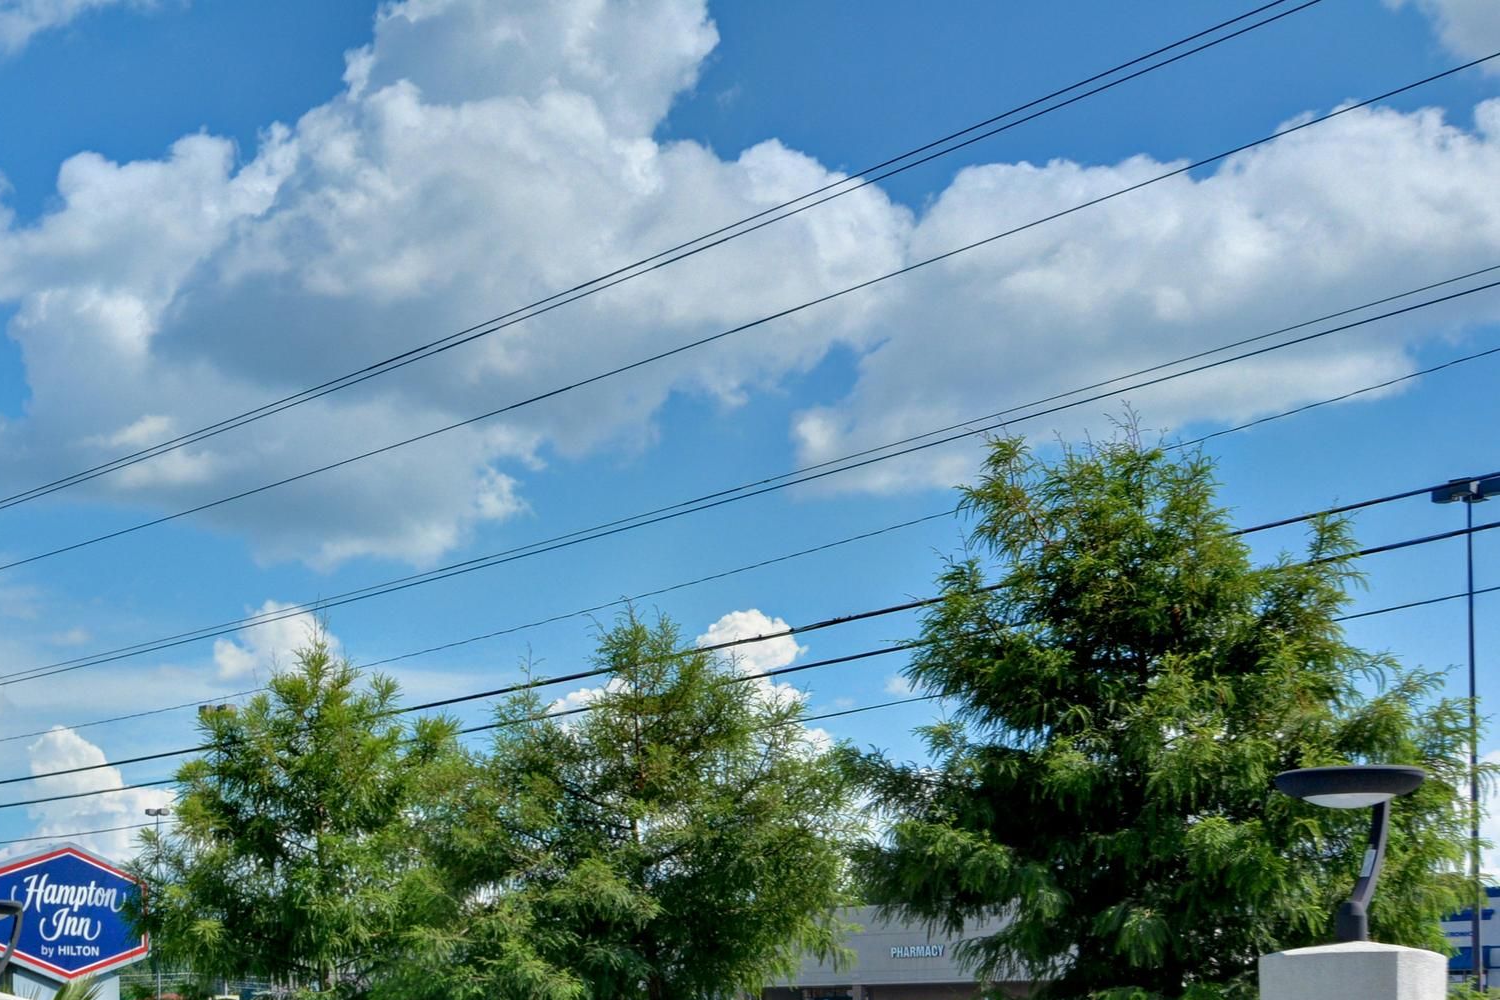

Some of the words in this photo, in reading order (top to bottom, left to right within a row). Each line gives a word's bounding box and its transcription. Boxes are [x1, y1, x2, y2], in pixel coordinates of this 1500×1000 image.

[11, 874, 126, 913] Hampton
[39, 908, 101, 941] Inn
[41, 945, 54, 957] by
[58, 945, 100, 957] HILTON
[891, 944, 945, 959] PHARMACY
